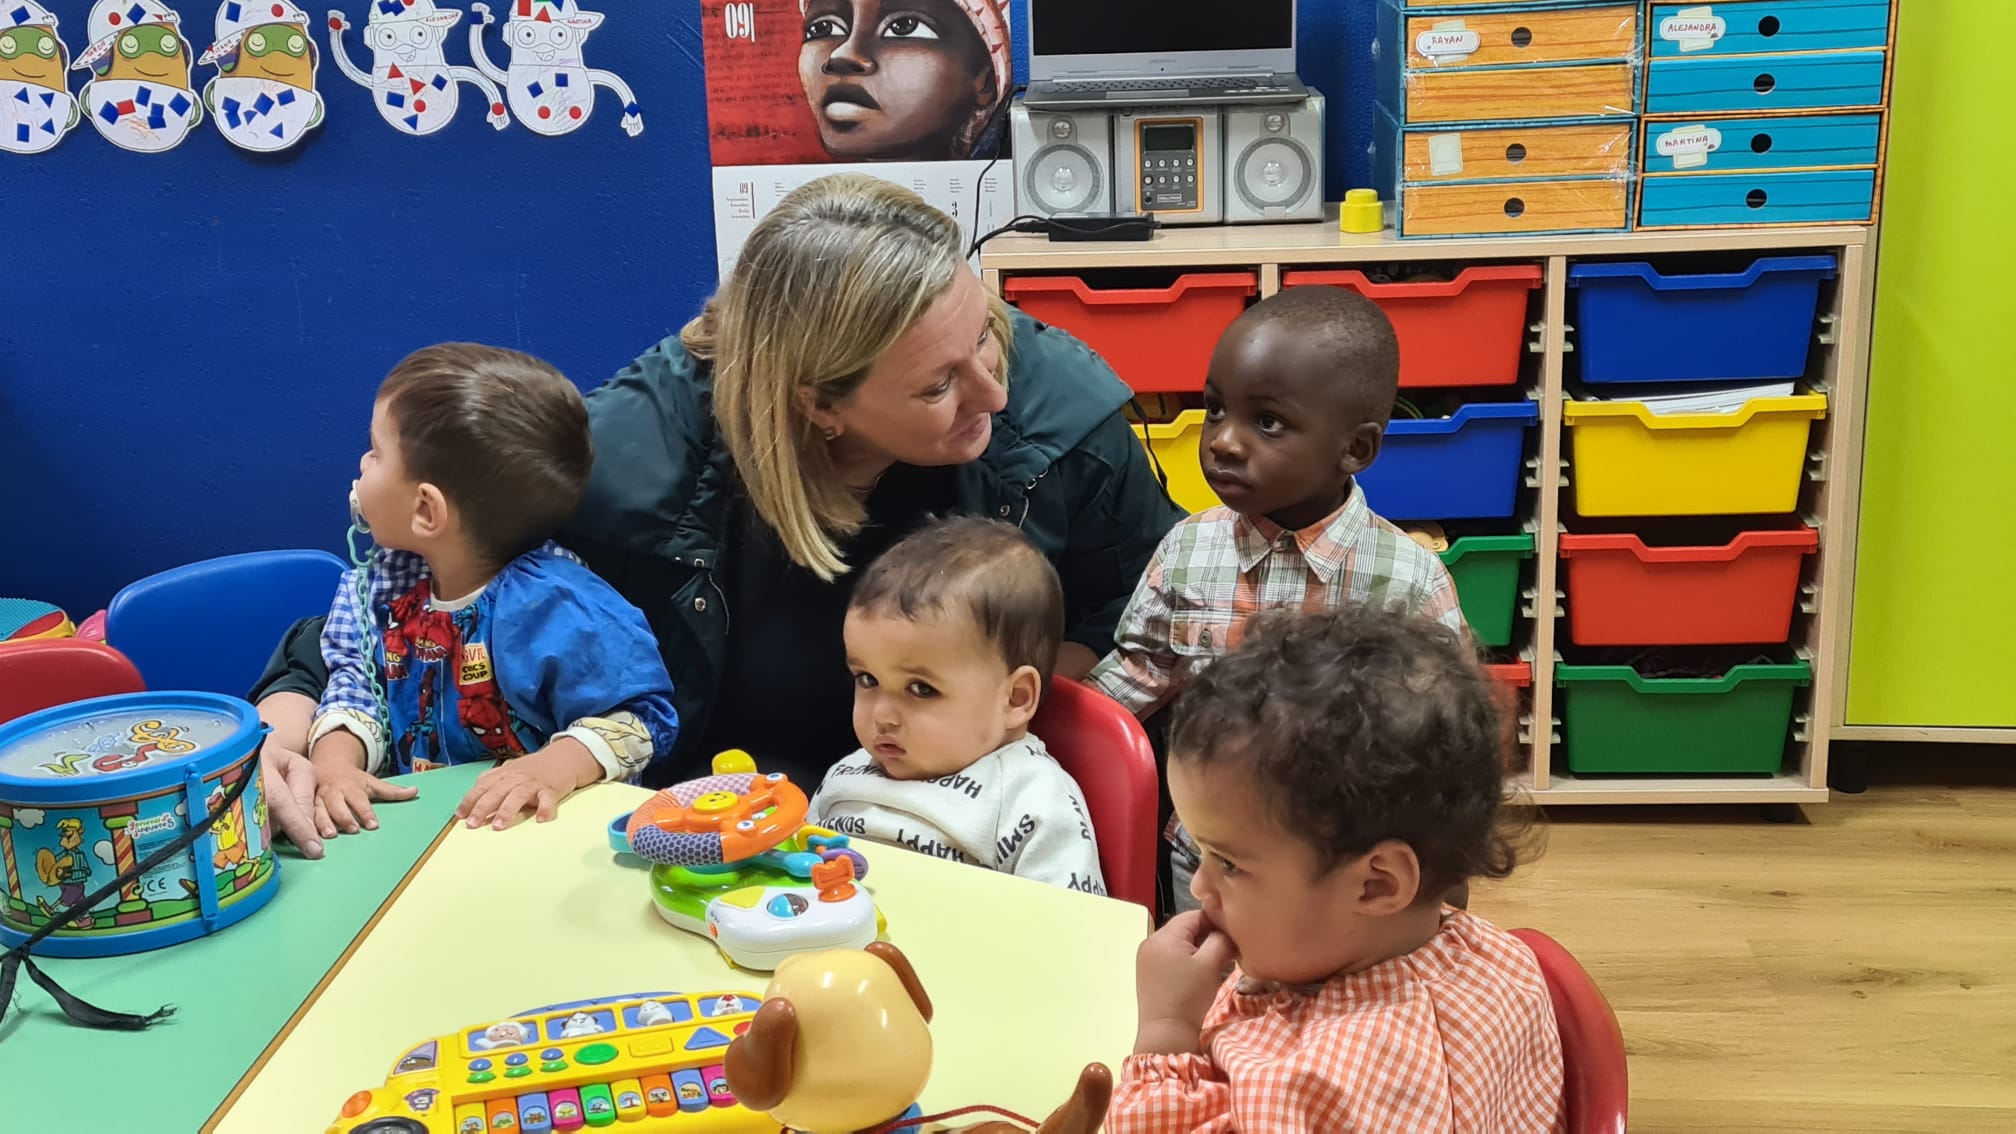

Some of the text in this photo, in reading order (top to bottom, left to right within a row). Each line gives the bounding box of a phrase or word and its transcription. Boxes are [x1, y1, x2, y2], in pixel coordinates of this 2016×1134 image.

[1668, 23, 1717, 32] ALEJANDRA
[1432, 35, 1463, 45] RAYAN
[1665, 136, 1708, 147] MARTINA
